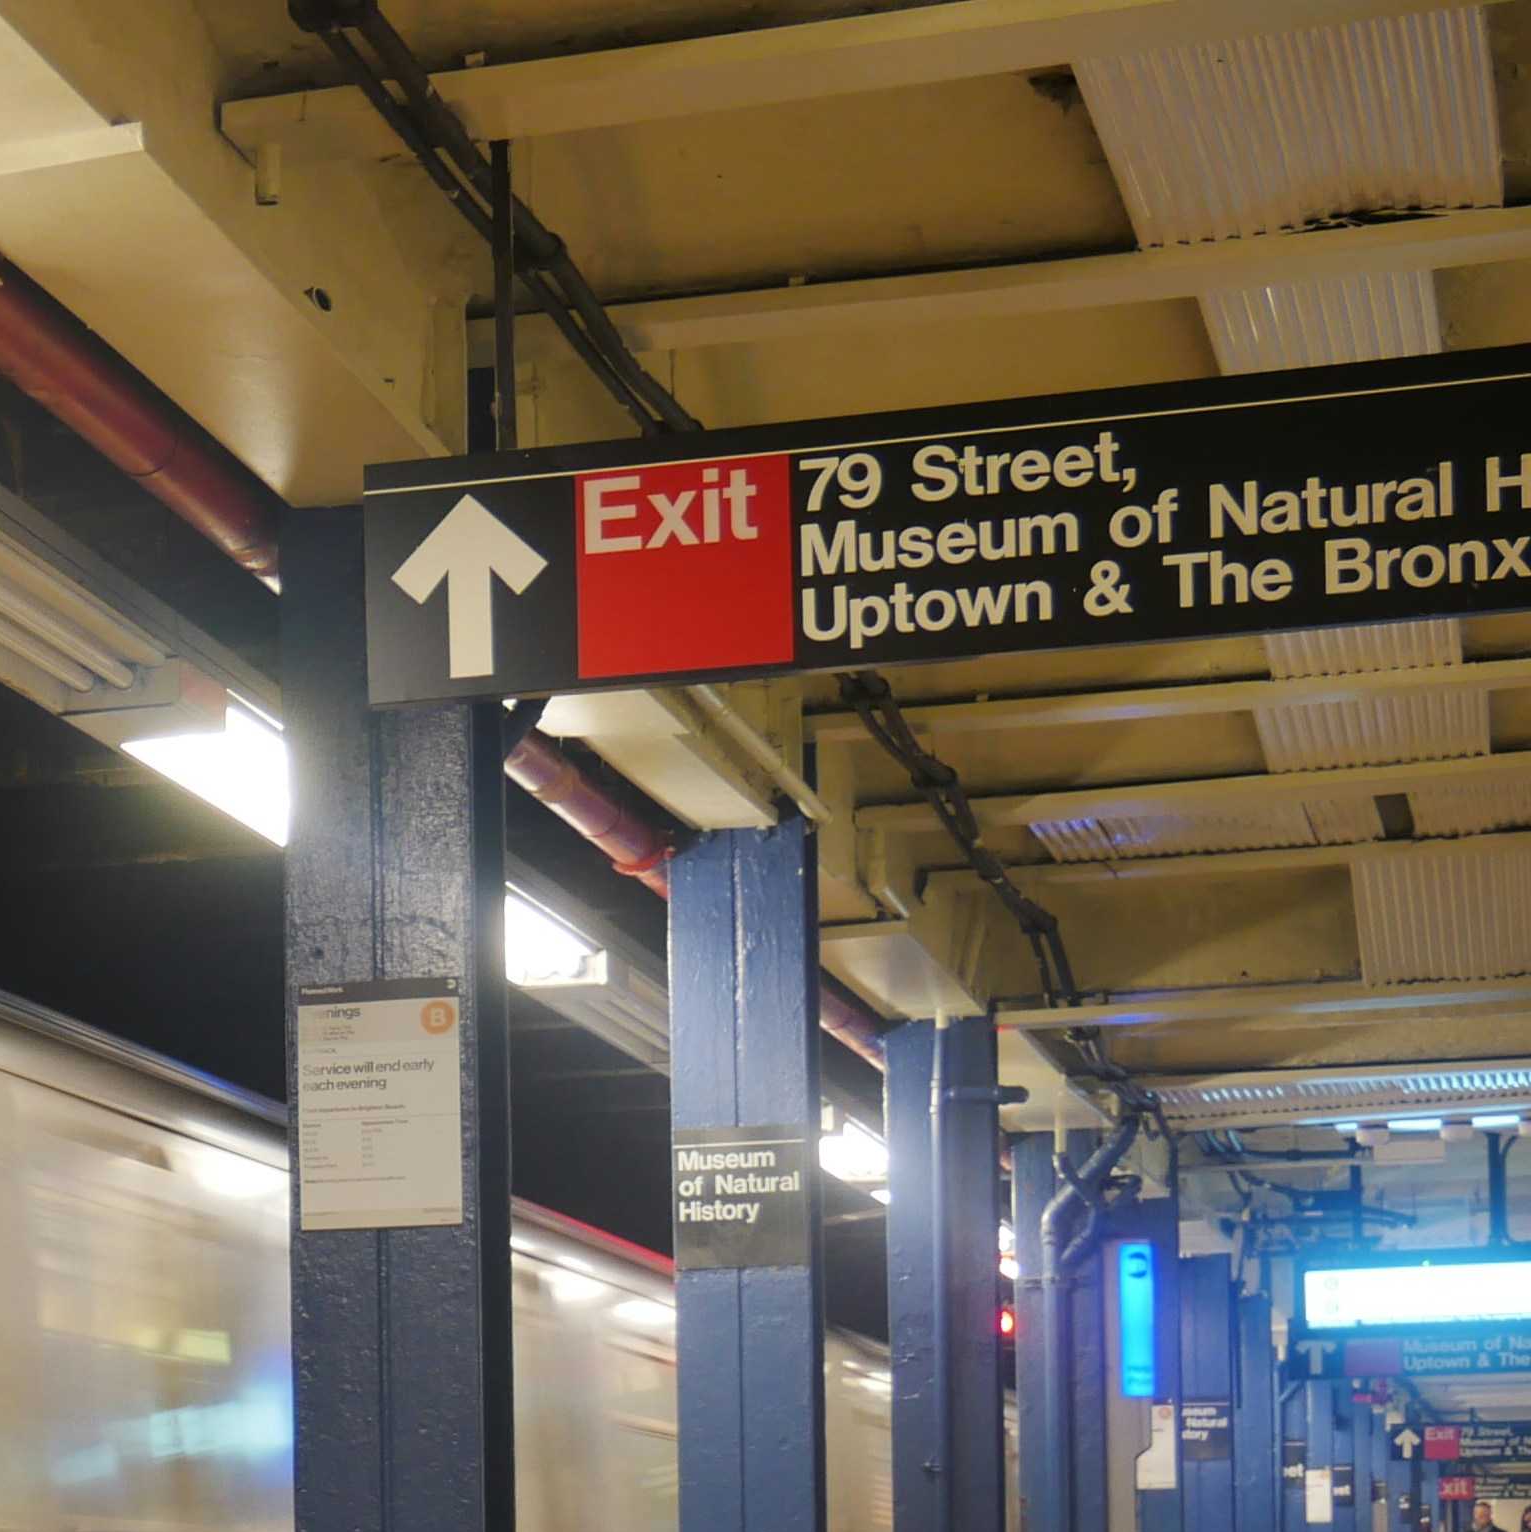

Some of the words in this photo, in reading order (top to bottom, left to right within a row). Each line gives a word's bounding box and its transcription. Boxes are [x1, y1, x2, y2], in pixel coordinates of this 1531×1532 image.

[798, 452, 883, 512] 79
[910, 431, 1137, 502] Street,
[583, 467, 759, 555] Exit
[800, 511, 1079, 577] Museum
[1108, 488, 1179, 548] of
[1208, 461, 1454, 539] Natural
[801, 579, 1053, 650] Uptown
[1082, 559, 1134, 617] &
[1161, 550, 1294, 608] The
[1324, 536, 1531, 596] Bronx
[302, 1061, 352, 1077] Service
[353, 1061, 374, 1074] will
[375, 1059, 401, 1073] end
[402, 1058, 435, 1073] early
[302, 1079, 335, 1092] each
[336, 1076, 387, 1091] evening
[677, 1150, 776, 1172] Museum
[678, 1175, 704, 1197] of
[714, 1171, 801, 1196] Natural
[678, 1200, 760, 1224] History
[1403, 1339, 1478, 1354] Museum
[1483, 1336, 1502, 1351] of
[1403, 1355, 1471, 1372] Uptown
[1424, 1426, 1454, 1440] Exit
